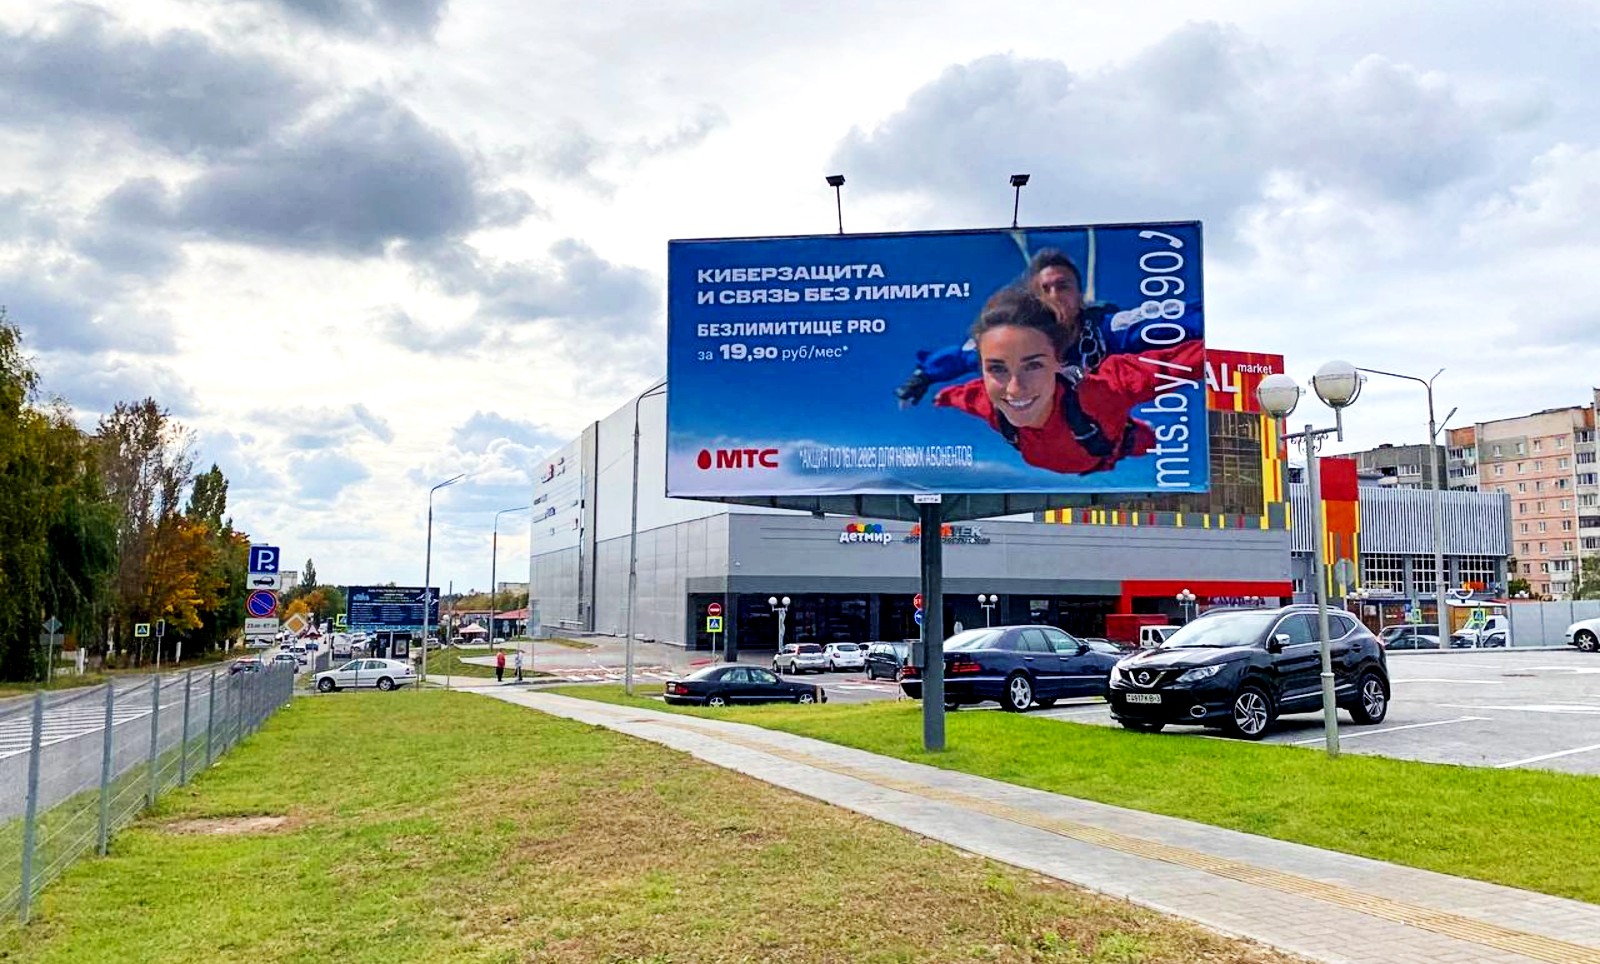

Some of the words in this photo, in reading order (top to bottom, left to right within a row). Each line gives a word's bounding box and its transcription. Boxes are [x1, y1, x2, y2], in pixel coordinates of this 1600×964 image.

[697, 264, 885, 284] КИБЕРЗАЩИТА
[697, 291, 714, 305] И
[719, 288, 800, 304] СВЯЗЬ
[804, 287, 850, 303] БЕЗ
[854, 283, 970, 301] ЛИМИТА!
[1139, 251, 1186, 345] 0890
[697, 320, 842, 337] БЕЗЛИМИТИЩЕ
[848, 319, 886, 334] PRO
[698, 351, 713, 361] за
[720, 344, 778, 362] 19,90
[1205, 361, 1240, 392] AL
[1237, 363, 1273, 375] market
[1138, 356, 1199, 488] mts.by/
[716, 449, 779, 468] МТС
[829, 447, 841, 468] ПО
[878, 447, 895, 470] ДЛЯ
[925, 445, 973, 468] АБОНЕНТОВ
[839, 531, 893, 545] детмир
[257, 549, 275, 571] P
